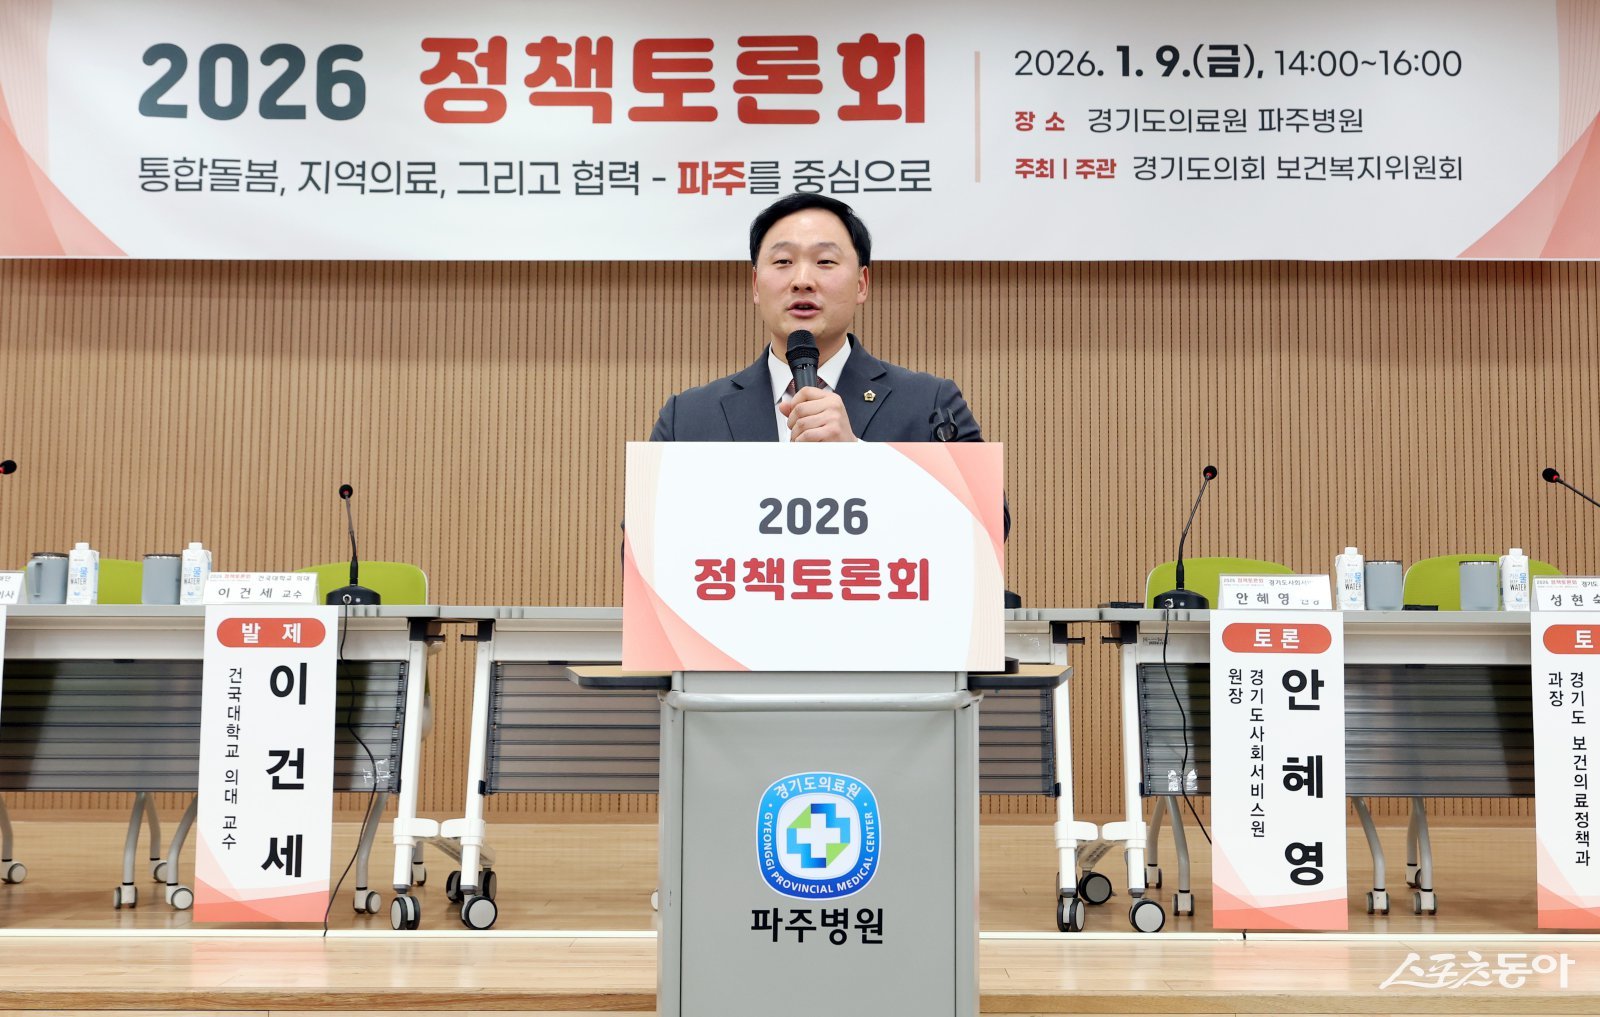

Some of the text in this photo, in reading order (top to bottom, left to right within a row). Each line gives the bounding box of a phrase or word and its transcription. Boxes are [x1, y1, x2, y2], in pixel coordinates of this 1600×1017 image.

[139, 32, 925, 125] 2026 정책토론회
[1015, 50, 1104, 76] 2026.
[1274, 50, 1462, 77] 14:00~16:00
[1089, 108, 1247, 133] 경기도의료원
[1258, 108, 1363, 133] 파주병원
[139, 157, 285, 196] 통합돌봄,
[298, 161, 445, 199] 지역의료,
[457, 161, 561, 196] 그리고
[572, 160, 639, 196] 협력
[677, 160, 781, 196] 파주를
[792, 159, 932, 194] 중심으로
[1015, 158, 1054, 179] 주최
[1076, 159, 1117, 179] 주관
[1134, 156, 1264, 181] 경기도의회
[1277, 155, 1462, 181] 보건복지위원회
[758, 497, 869, 536] 2026
[694, 557, 930, 601] 정책토론회
[1228, 668, 1243, 705] 원장
[1547, 671, 1564, 707] 과장
[221, 667, 243, 850] 건국대학교 의대 교수
[1249, 668, 1265, 838] 경기도사회서비스원
[1569, 671, 1591, 867] 경기도 보건의료정책과
[773, 776, 862, 801] 경기도의료원
[763, 811, 875, 894] GYEONGGI PROVINCIAL MEDICAL CENTER
[750, 907, 883, 946] 파주병원
